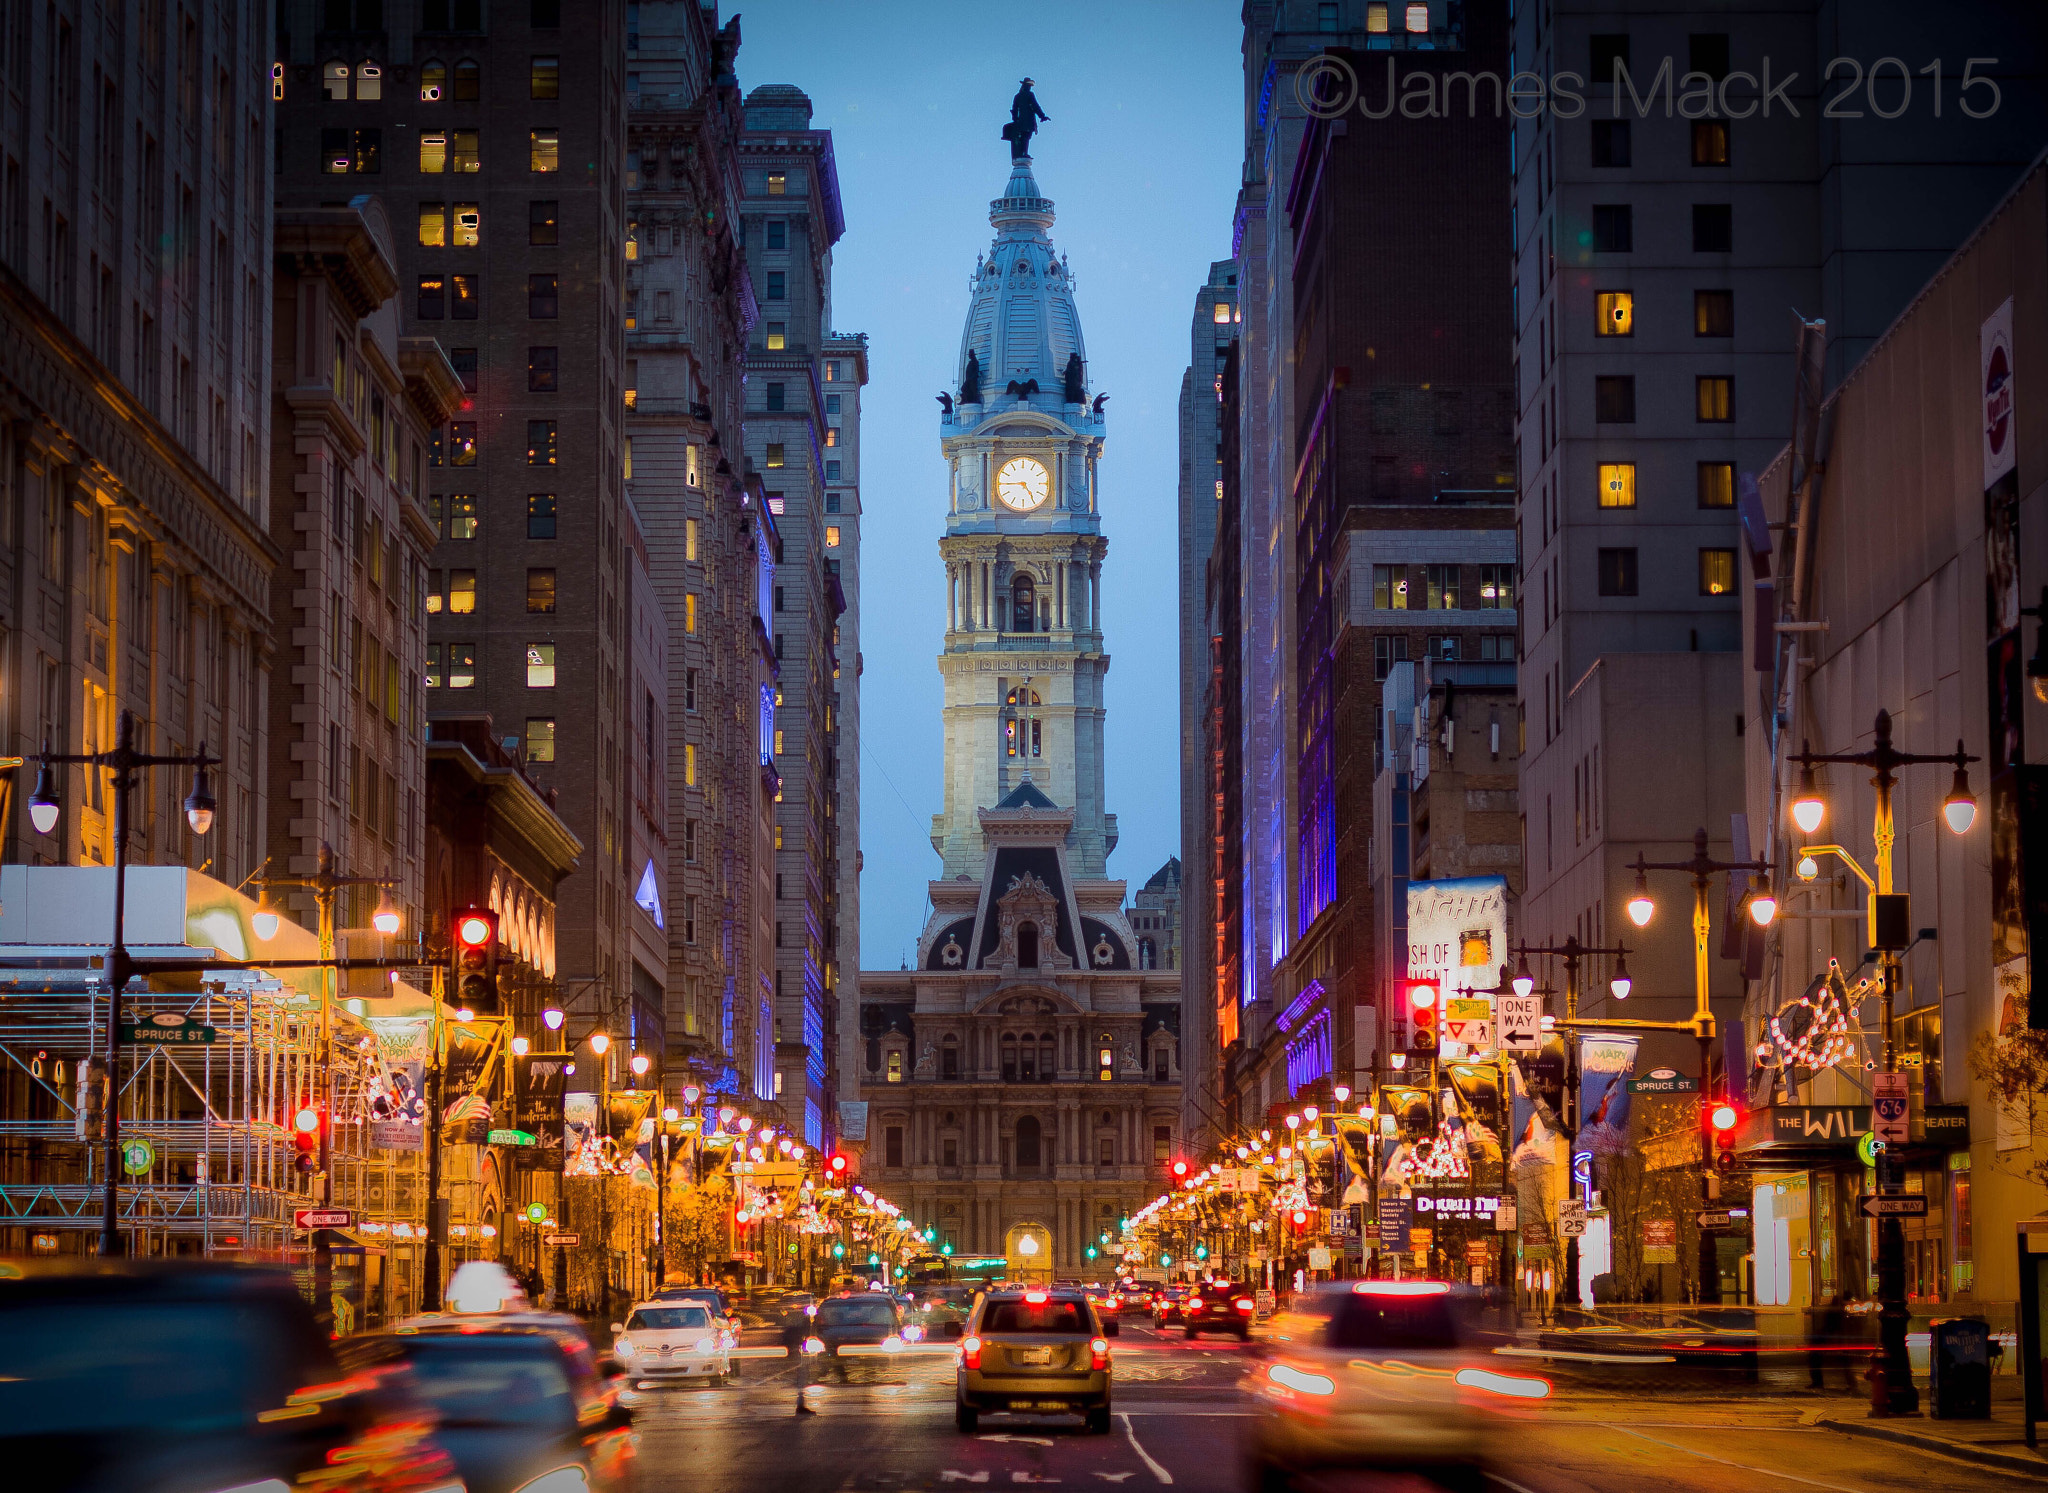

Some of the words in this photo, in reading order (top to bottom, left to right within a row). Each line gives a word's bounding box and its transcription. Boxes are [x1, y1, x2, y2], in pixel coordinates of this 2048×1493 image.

[1433, 943, 1450, 965] OF
[1505, 1000, 1532, 1012] ONE
[1504, 1015, 1533, 1027] WAY
[134, 1029, 183, 1040] SPRUCE
[188, 1031, 205, 1041] ST.
[380, 1035, 416, 1047] MARY
[1594, 1048, 1627, 1059] MARY
[1636, 1082, 1674, 1091] SPRUCE
[1678, 1081, 1692, 1089] ST.
[1884, 1075, 1897, 1085] TO
[535, 1100, 547, 1113] the
[1880, 1100, 1902, 1115] 676
[1777, 1118, 1802, 1128] THE
[1804, 1109, 1874, 1140] WIL
[1923, 1117, 1967, 1128] HEATER
[1562, 1203, 1584, 1211] SPEED
[1880, 1202, 1899, 1211] ONE
[1901, 1202, 1921, 1210] WAY
[312, 1215, 328, 1223] ONE
[330, 1215, 345, 1223] WAY
[1332, 1215, 1345, 1227] H
[1717, 1215, 1728, 1223] WAY
[1563, 1220, 1585, 1233] 25
